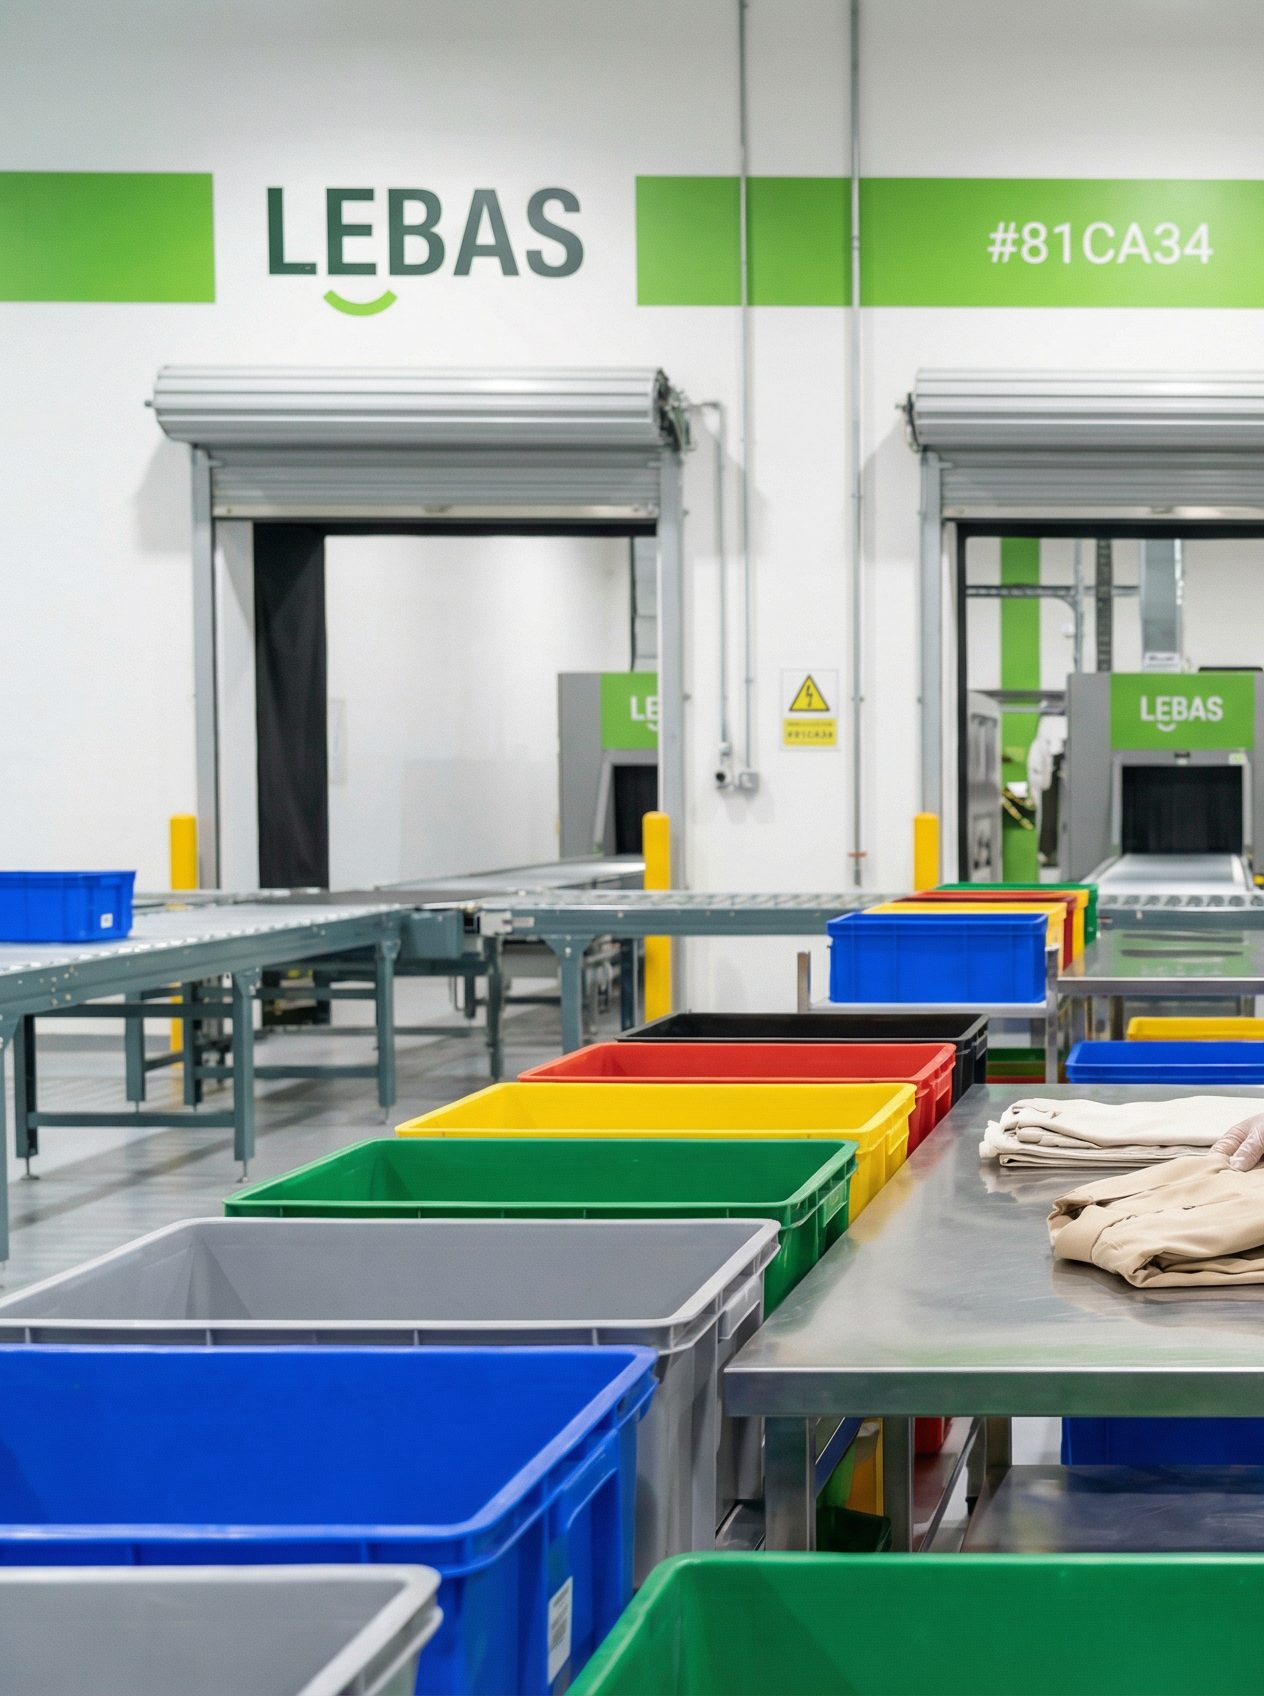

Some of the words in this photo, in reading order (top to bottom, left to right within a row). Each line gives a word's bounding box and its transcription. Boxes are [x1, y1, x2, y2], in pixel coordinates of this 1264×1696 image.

[266, 187, 584, 278] LEBAS
[986, 221, 1214, 266] #81CA34
[1139, 695, 1224, 722] LEBAS
